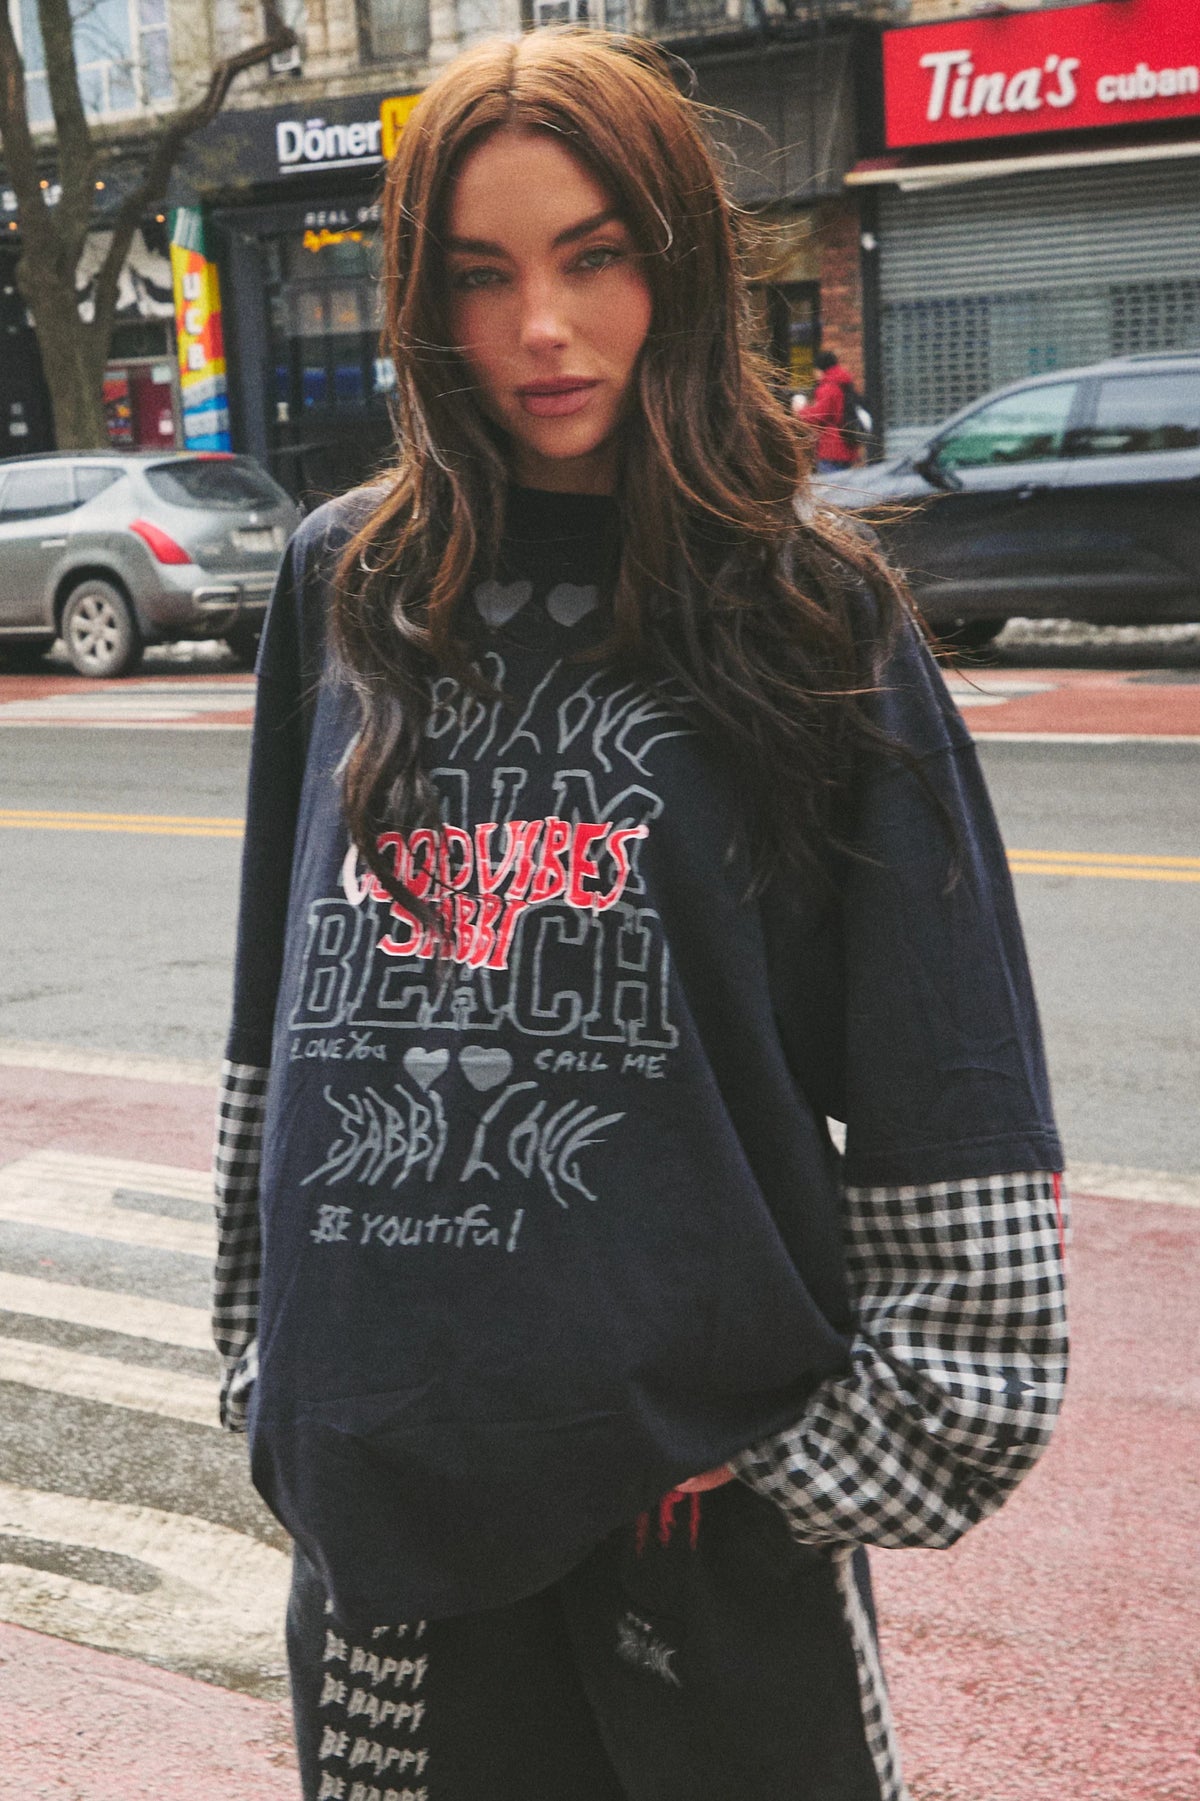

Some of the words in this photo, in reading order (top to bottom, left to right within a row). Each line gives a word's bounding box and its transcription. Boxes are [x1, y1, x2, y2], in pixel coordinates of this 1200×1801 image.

[918, 49, 1080, 122] Tina's
[1096, 62, 1199, 103] cuban
[289, 1038, 343, 1060] LOVE
[533, 1048, 607, 1074] CALL
[620, 1051, 668, 1079] ME
